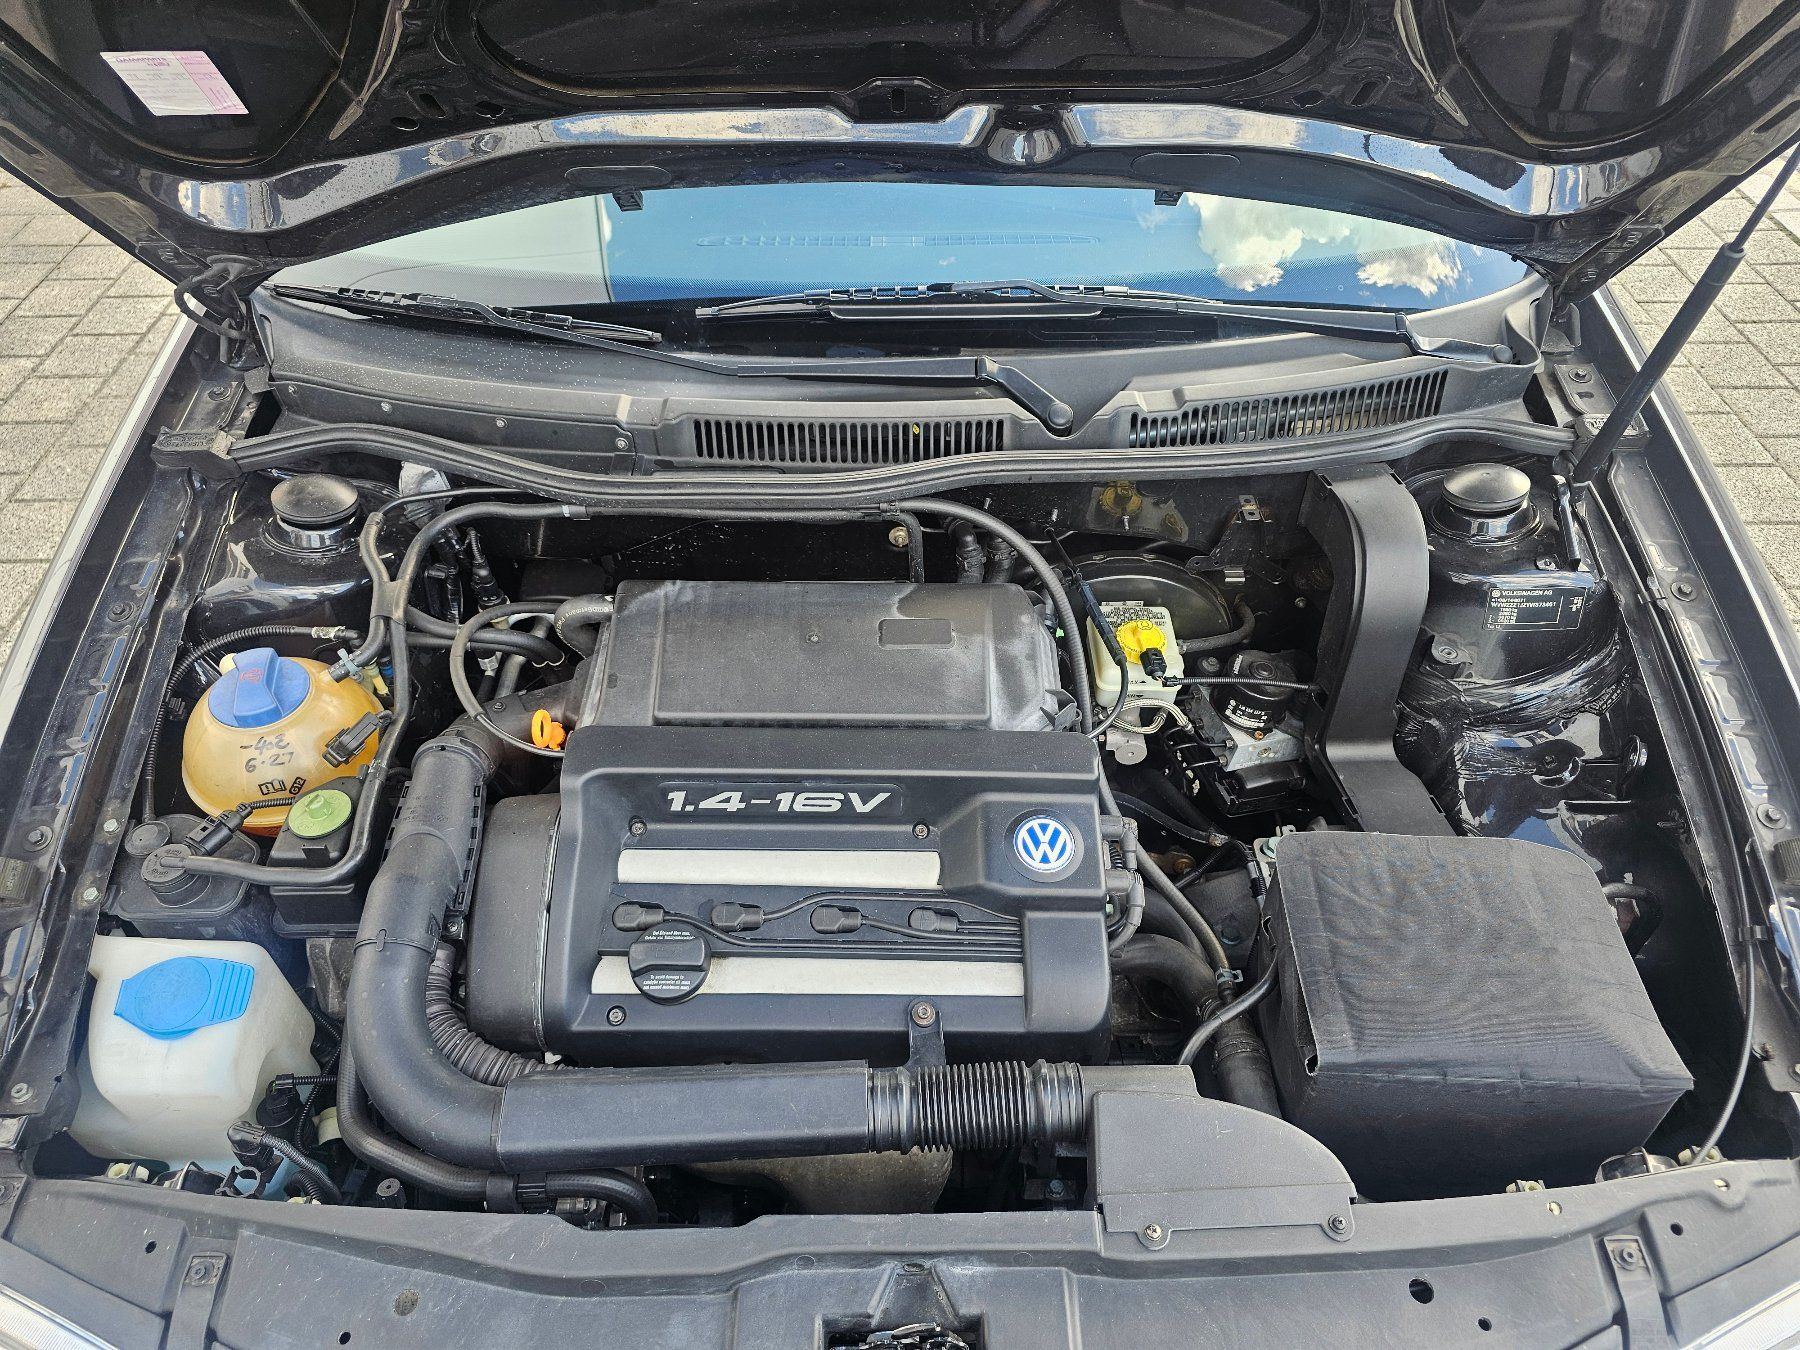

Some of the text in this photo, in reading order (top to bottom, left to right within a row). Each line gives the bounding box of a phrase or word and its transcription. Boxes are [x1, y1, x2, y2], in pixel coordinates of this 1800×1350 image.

[290, 777, 305, 795] G12
[667, 790, 892, 813] 1.4-16V
[1016, 817, 1074, 871] VW
